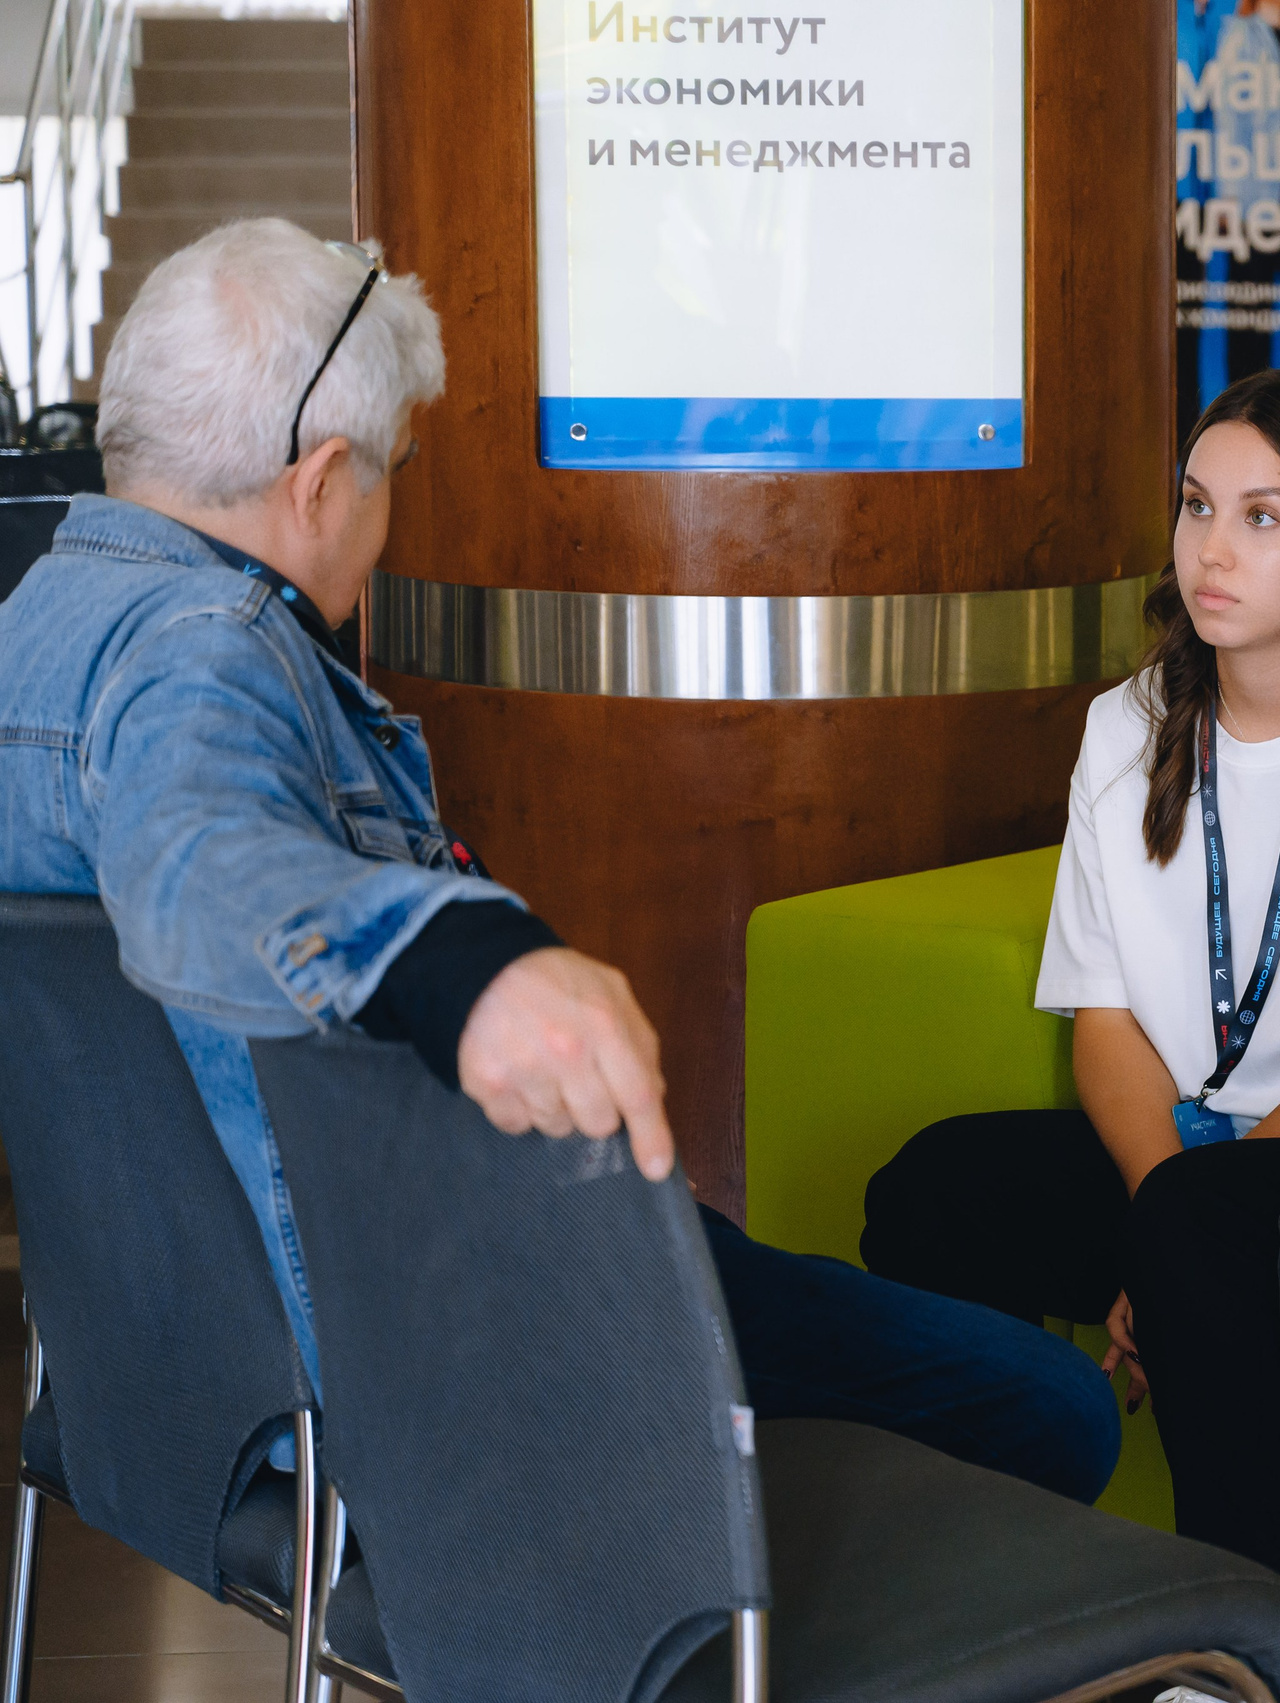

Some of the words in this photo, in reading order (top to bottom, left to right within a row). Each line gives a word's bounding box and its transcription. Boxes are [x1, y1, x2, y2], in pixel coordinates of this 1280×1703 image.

[588, 0, 826, 55] Институт
[586, 76, 865, 107] экономики
[588, 139, 614, 166] и
[630, 139, 971, 172] менеджмента
[1209, 837, 1220, 896] СЕГОДНЯ
[1213, 901, 1224, 958] БУДУЩЕЕ
[1252, 946, 1276, 1002] СЕГОДНЯ
